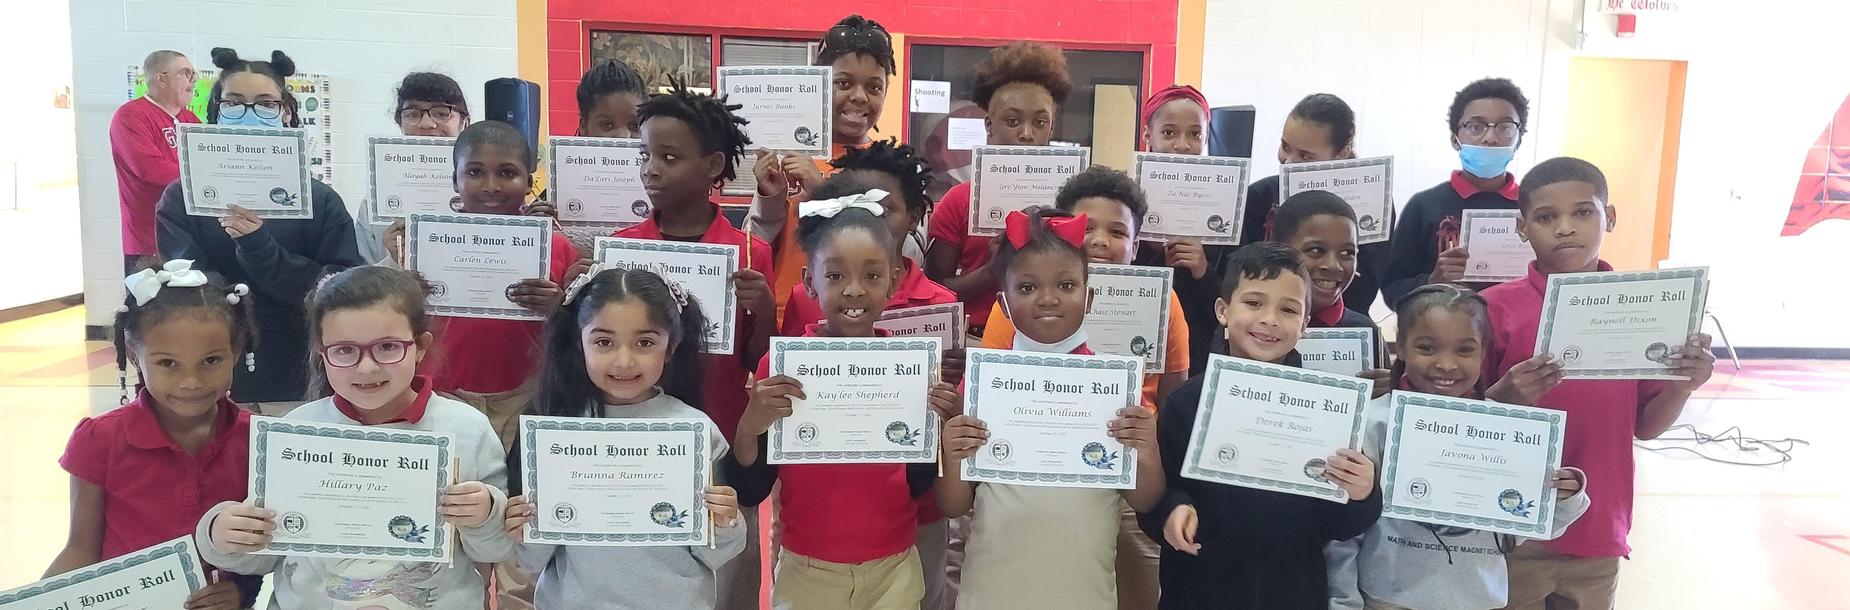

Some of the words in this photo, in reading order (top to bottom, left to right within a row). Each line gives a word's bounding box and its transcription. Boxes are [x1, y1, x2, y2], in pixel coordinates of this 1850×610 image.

[733, 84, 762, 94] School
[766, 84, 793, 95] Honor
[798, 84, 817, 94] Roll
[914, 88, 946, 97] Shooting
[197, 142, 230, 153] School
[236, 144, 267, 154] Honor
[272, 145, 293, 155] Roll
[384, 153, 414, 163] School
[419, 154, 448, 164] Honor
[565, 156, 596, 165] School
[601, 156, 630, 166] Honor
[990, 164, 1020, 173] School
[1025, 164, 1052, 175] Honor
[1056, 164, 1075, 174] Roll
[1149, 170, 1179, 180] School
[1184, 172, 1212, 182] Honor
[1216, 174, 1234, 183] Roll
[1297, 180, 1328, 189] School
[1333, 178, 1358, 188] Honor
[1363, 174, 1380, 184] Roll
[1479, 226, 1509, 234] School
[428, 233, 466, 244] School
[472, 235, 506, 246] Honor
[511, 236, 534, 247] Roll
[453, 256, 481, 264] Carlen
[483, 257, 507, 265] Lewis
[697, 264, 721, 276] Roll
[1107, 286, 1134, 298] Honor
[1138, 286, 1157, 298] Roll
[1569, 295, 1610, 307] School
[1617, 293, 1655, 305] Honor
[1660, 290, 1686, 302] Roll
[1629, 316, 1658, 324] Dixon
[923, 322, 946, 333] Roll
[1302, 353, 1326, 361] onor
[1332, 350, 1355, 361] Roll
[797, 364, 840, 377] School
[848, 364, 887, 378] Honor
[894, 363, 920, 376] Roll
[991, 377, 1035, 392] School
[1043, 379, 1084, 394] Honor
[1091, 381, 1119, 395] Roll
[855, 390, 902, 401] Shepherd
[1229, 385, 1272, 402] School
[1279, 392, 1316, 409] Honor
[1322, 398, 1348, 414] Roll
[1013, 406, 1044, 416] Olivia
[1049, 407, 1092, 418] Williams
[1256, 416, 1283, 428] Derek
[1414, 418, 1459, 435] School
[1465, 424, 1506, 441] Honor
[1513, 430, 1542, 446] Roll
[549, 443, 598, 457] School
[605, 444, 649, 458] Honor
[657, 443, 686, 456] Roll
[1439, 449, 1476, 461] Javona
[1480, 454, 1508, 464] Willis
[281, 447, 333, 464] School
[342, 452, 389, 468] Honor
[397, 456, 429, 470] Roll
[569, 471, 614, 479] Brianna
[618, 471, 665, 479] Ramirez
[318, 479, 362, 492] Hillary
[366, 482, 389, 492] Paz
[1387, 535, 1406, 546] MATH
[1407, 540, 1422, 549] AND
[1460, 546, 1487, 554] MAGNET
[78, 585, 131, 608] Honor
[138, 569, 176, 590] Roll
